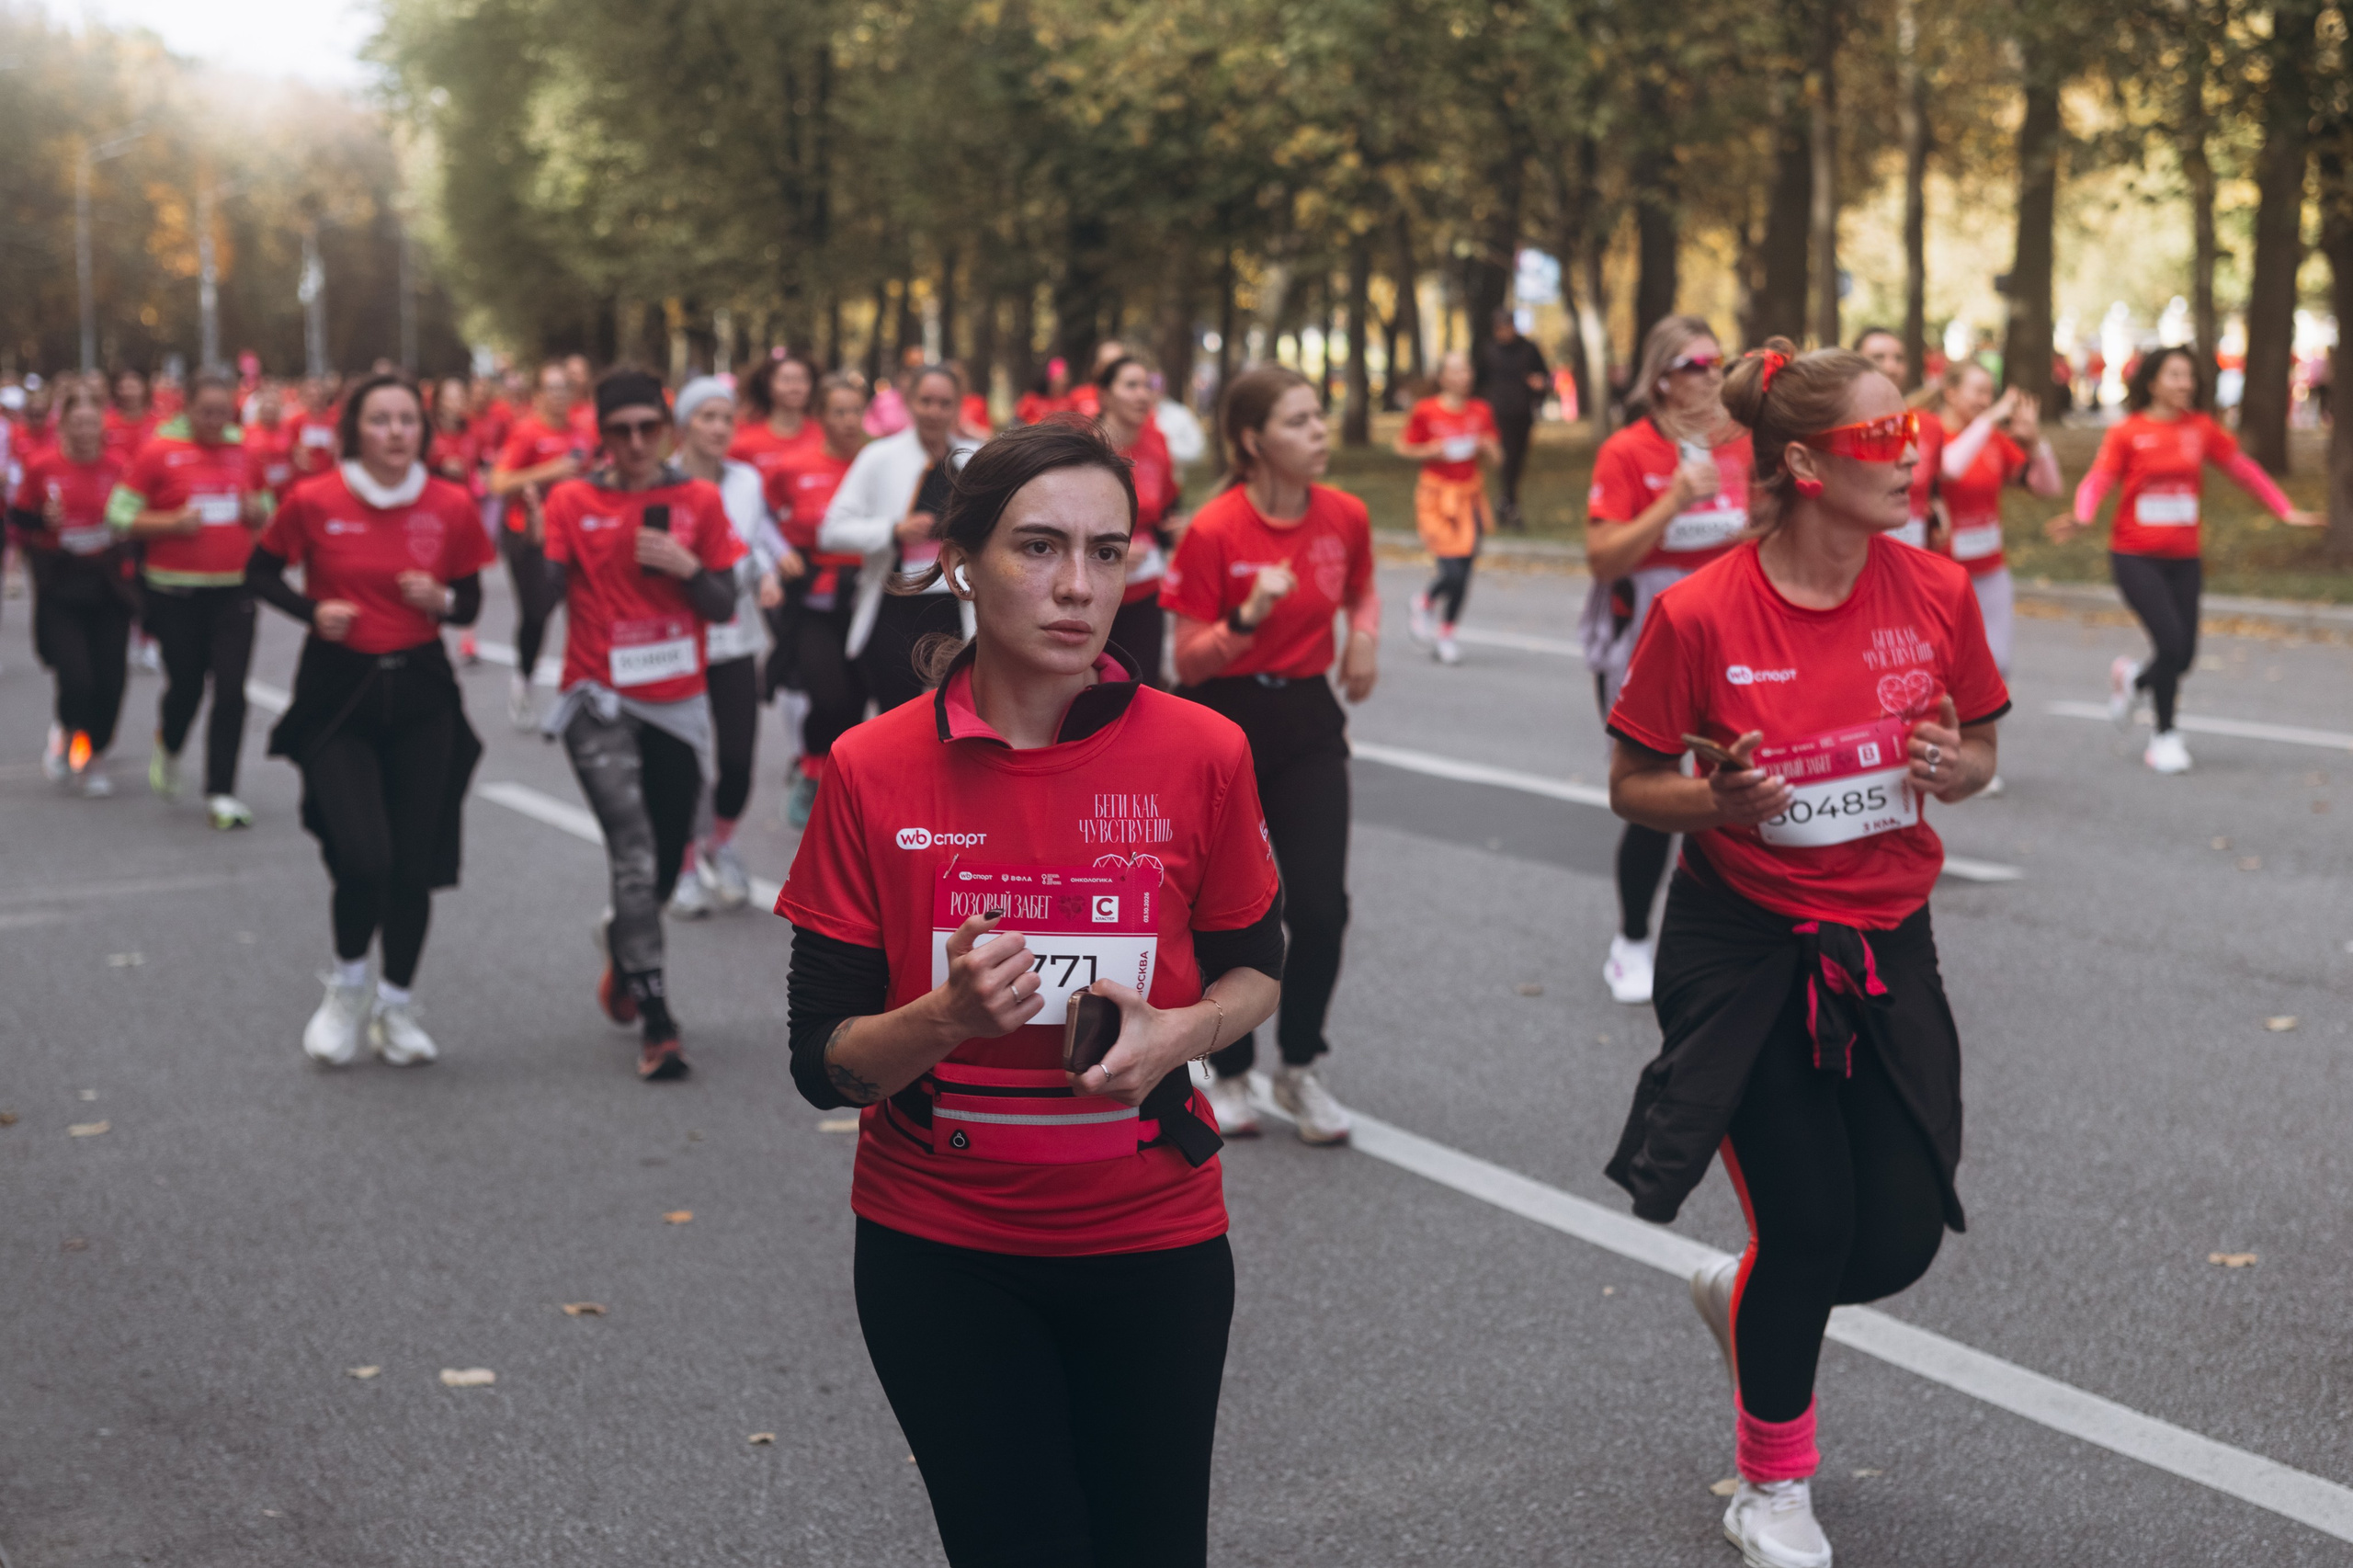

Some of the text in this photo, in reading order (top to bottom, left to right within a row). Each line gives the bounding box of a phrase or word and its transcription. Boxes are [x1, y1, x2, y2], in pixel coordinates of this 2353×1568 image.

[1095, 794, 1159, 818] БЕГИ КАК
[1079, 818, 1173, 843] ЧУВСТВУЕШЬ
[950, 891, 1052, 919] РОЗОВЫЙ ЗАБЕГ
[1136, 950, 1149, 995] ОСКВА
